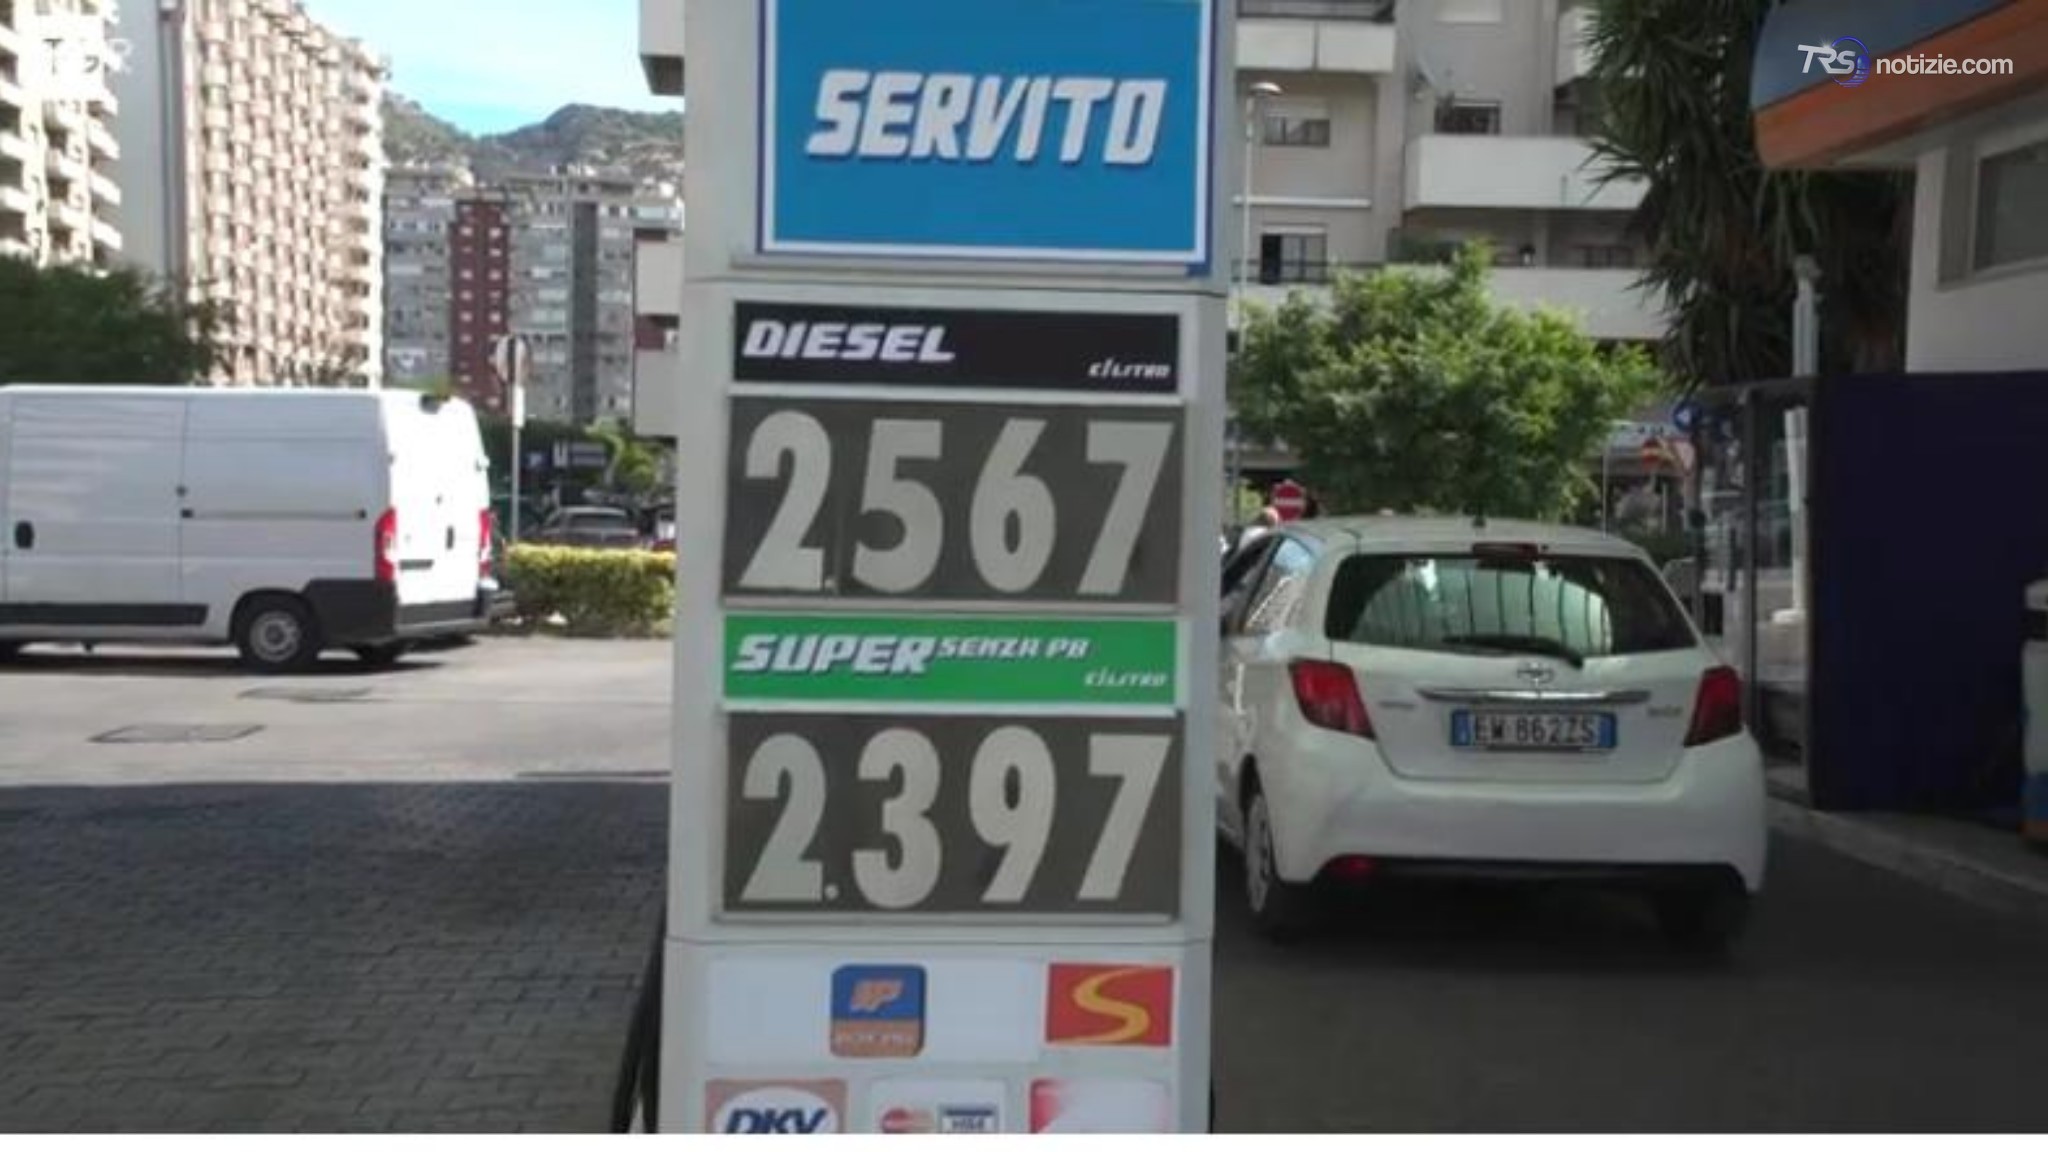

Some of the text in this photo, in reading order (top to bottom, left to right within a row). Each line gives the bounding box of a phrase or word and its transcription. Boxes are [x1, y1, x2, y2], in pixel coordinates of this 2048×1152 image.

[805, 68, 1168, 165] SERVITO
[742, 320, 956, 364] DIESEL
[738, 409, 1175, 595] 2.567
[732, 633, 938, 675] SUPER
[935, 635, 1041, 658] SENZA
[740, 724, 1172, 909] 2.397
[725, 1106, 829, 1134] DKV
